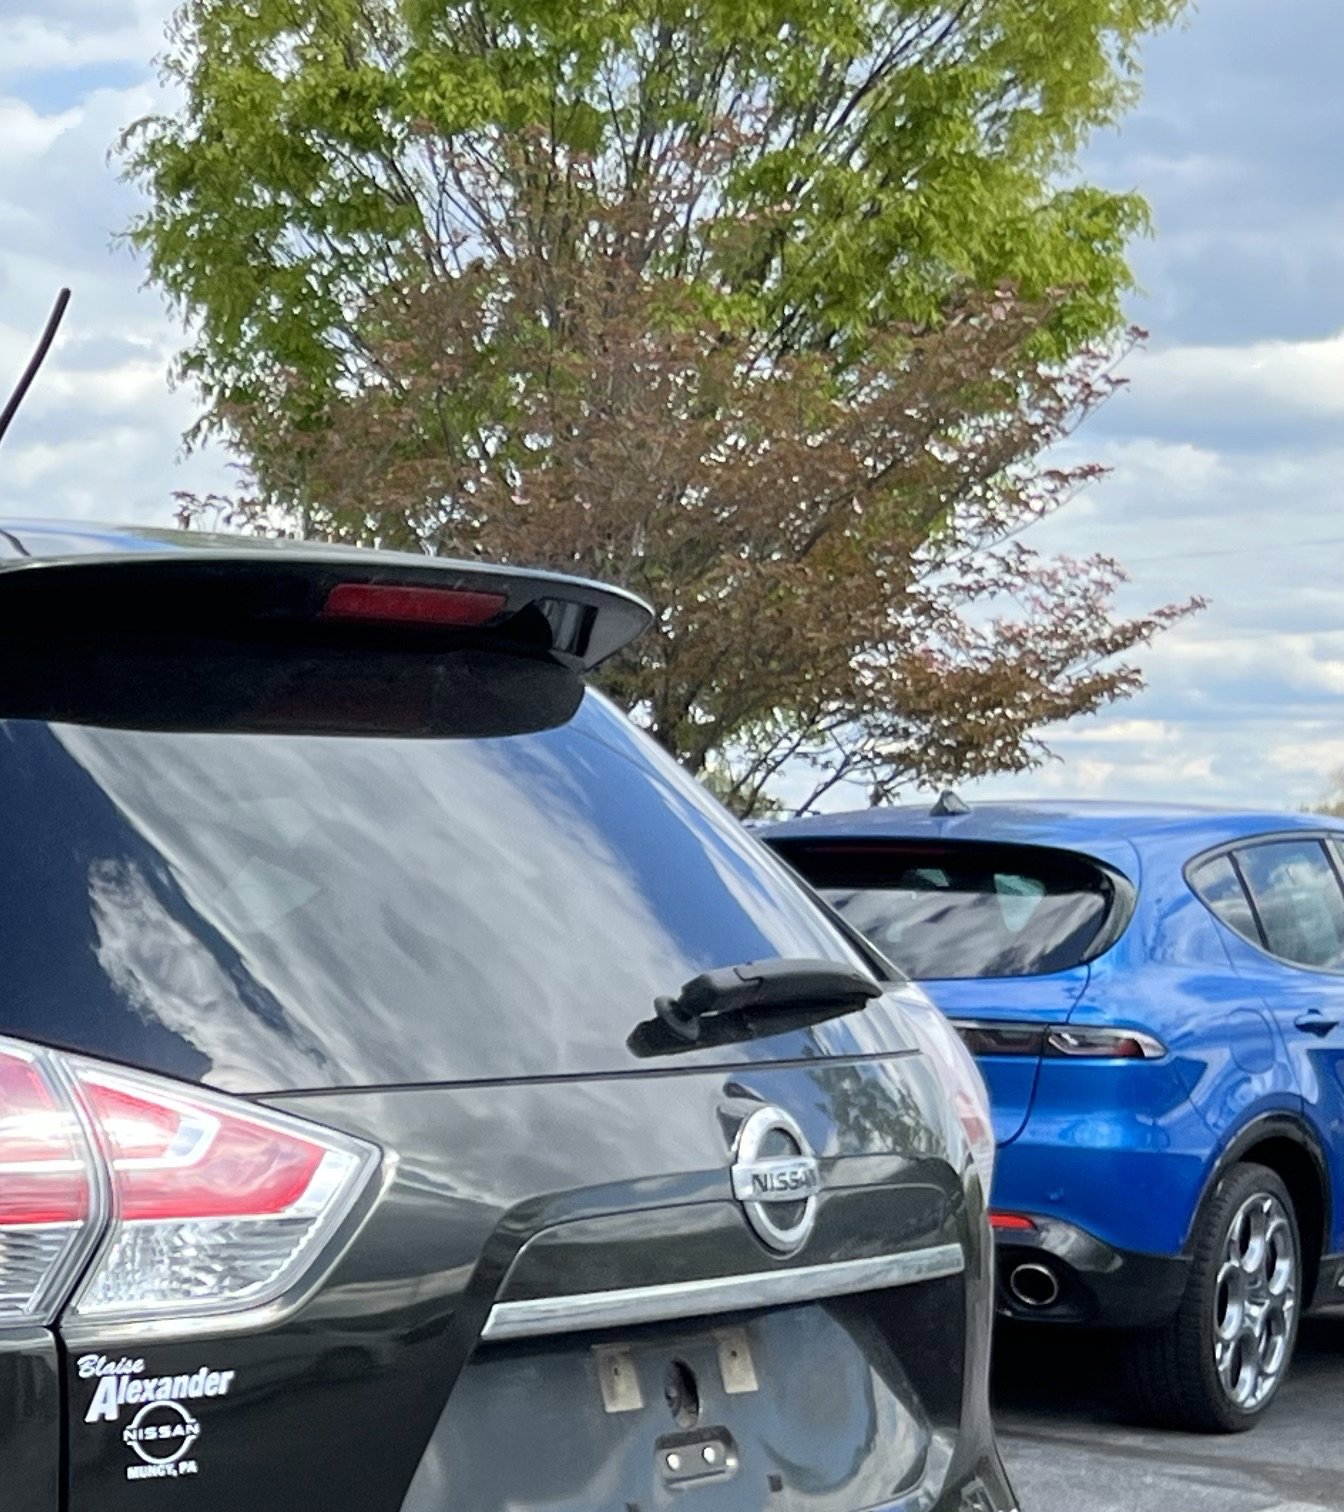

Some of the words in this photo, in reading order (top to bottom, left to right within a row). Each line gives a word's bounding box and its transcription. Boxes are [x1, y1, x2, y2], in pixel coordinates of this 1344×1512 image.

[752, 1168, 817, 1192] NISSAN
[77, 1354, 145, 1378] Blaise
[84, 1366, 235, 1423] Alexander
[123, 1423, 201, 1441] NISSAN
[179, 1460, 198, 1475] PA
